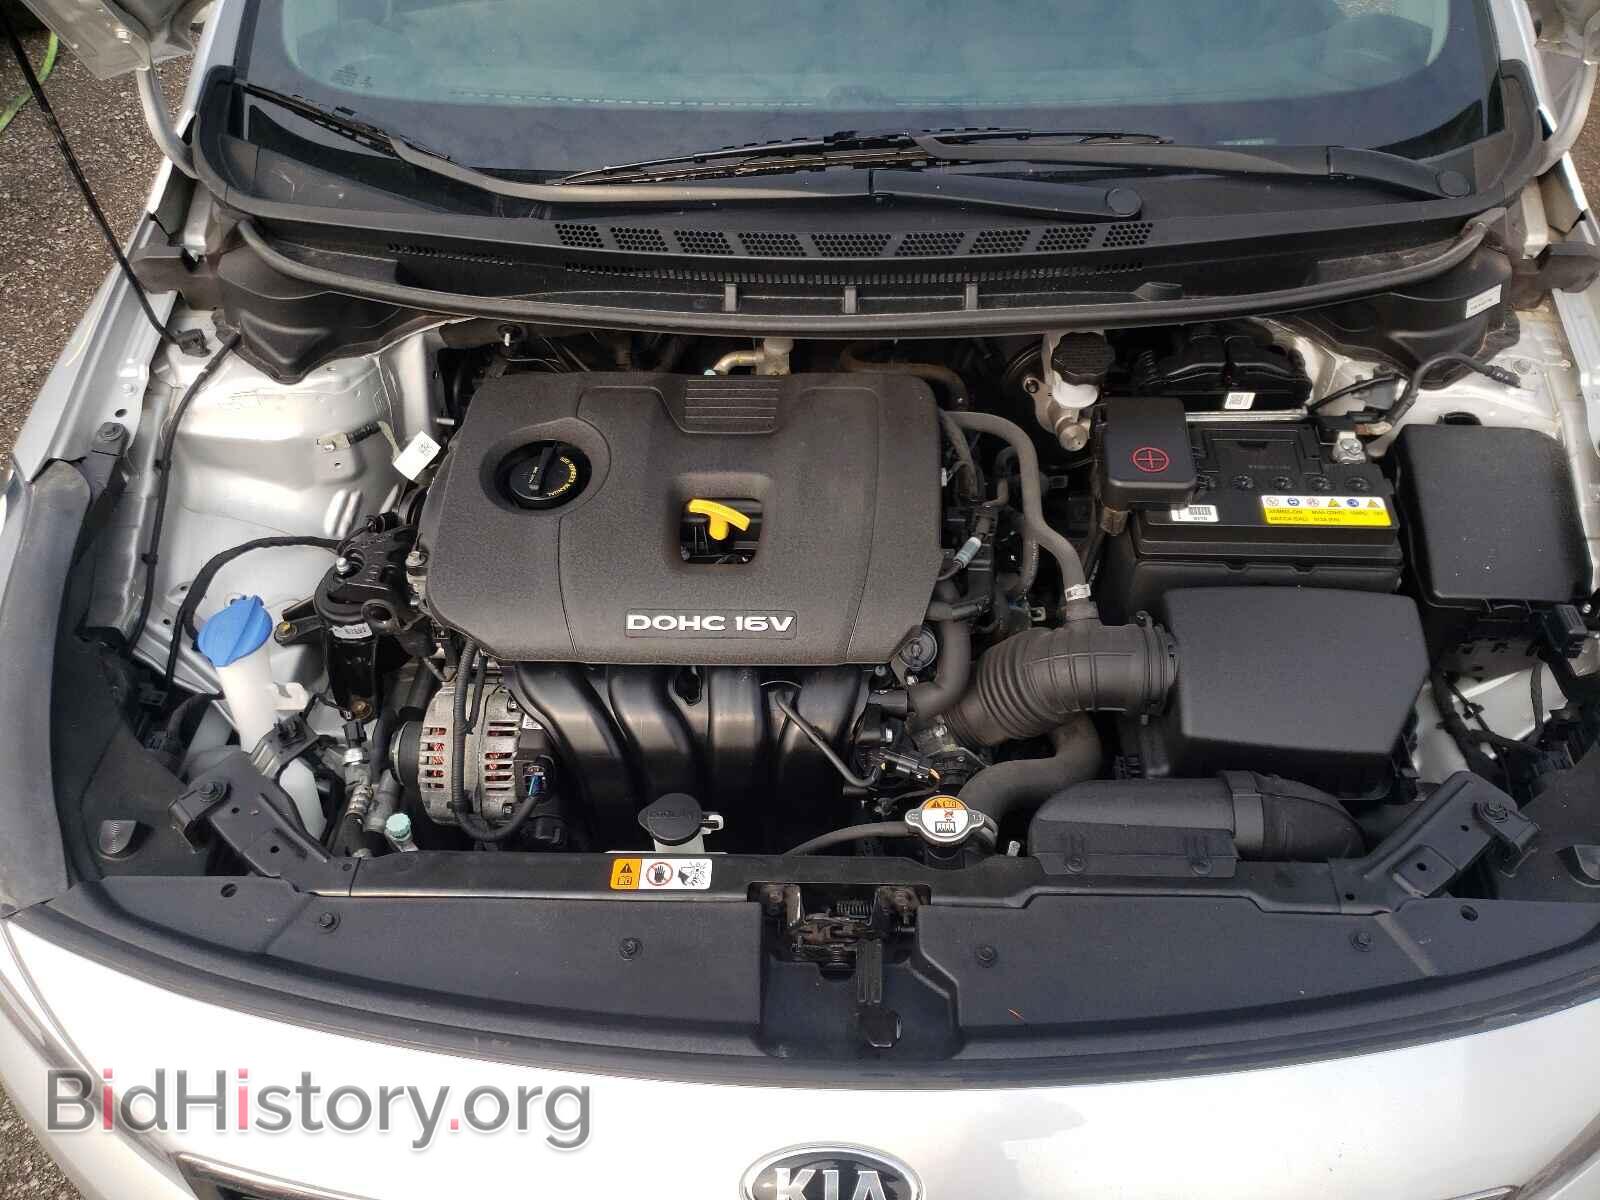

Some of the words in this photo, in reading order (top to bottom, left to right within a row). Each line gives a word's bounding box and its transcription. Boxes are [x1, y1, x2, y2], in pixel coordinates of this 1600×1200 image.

[626, 614, 726, 632] DOHC
[735, 615, 794, 632] 16V
[774, 1167, 888, 1200] KIA
